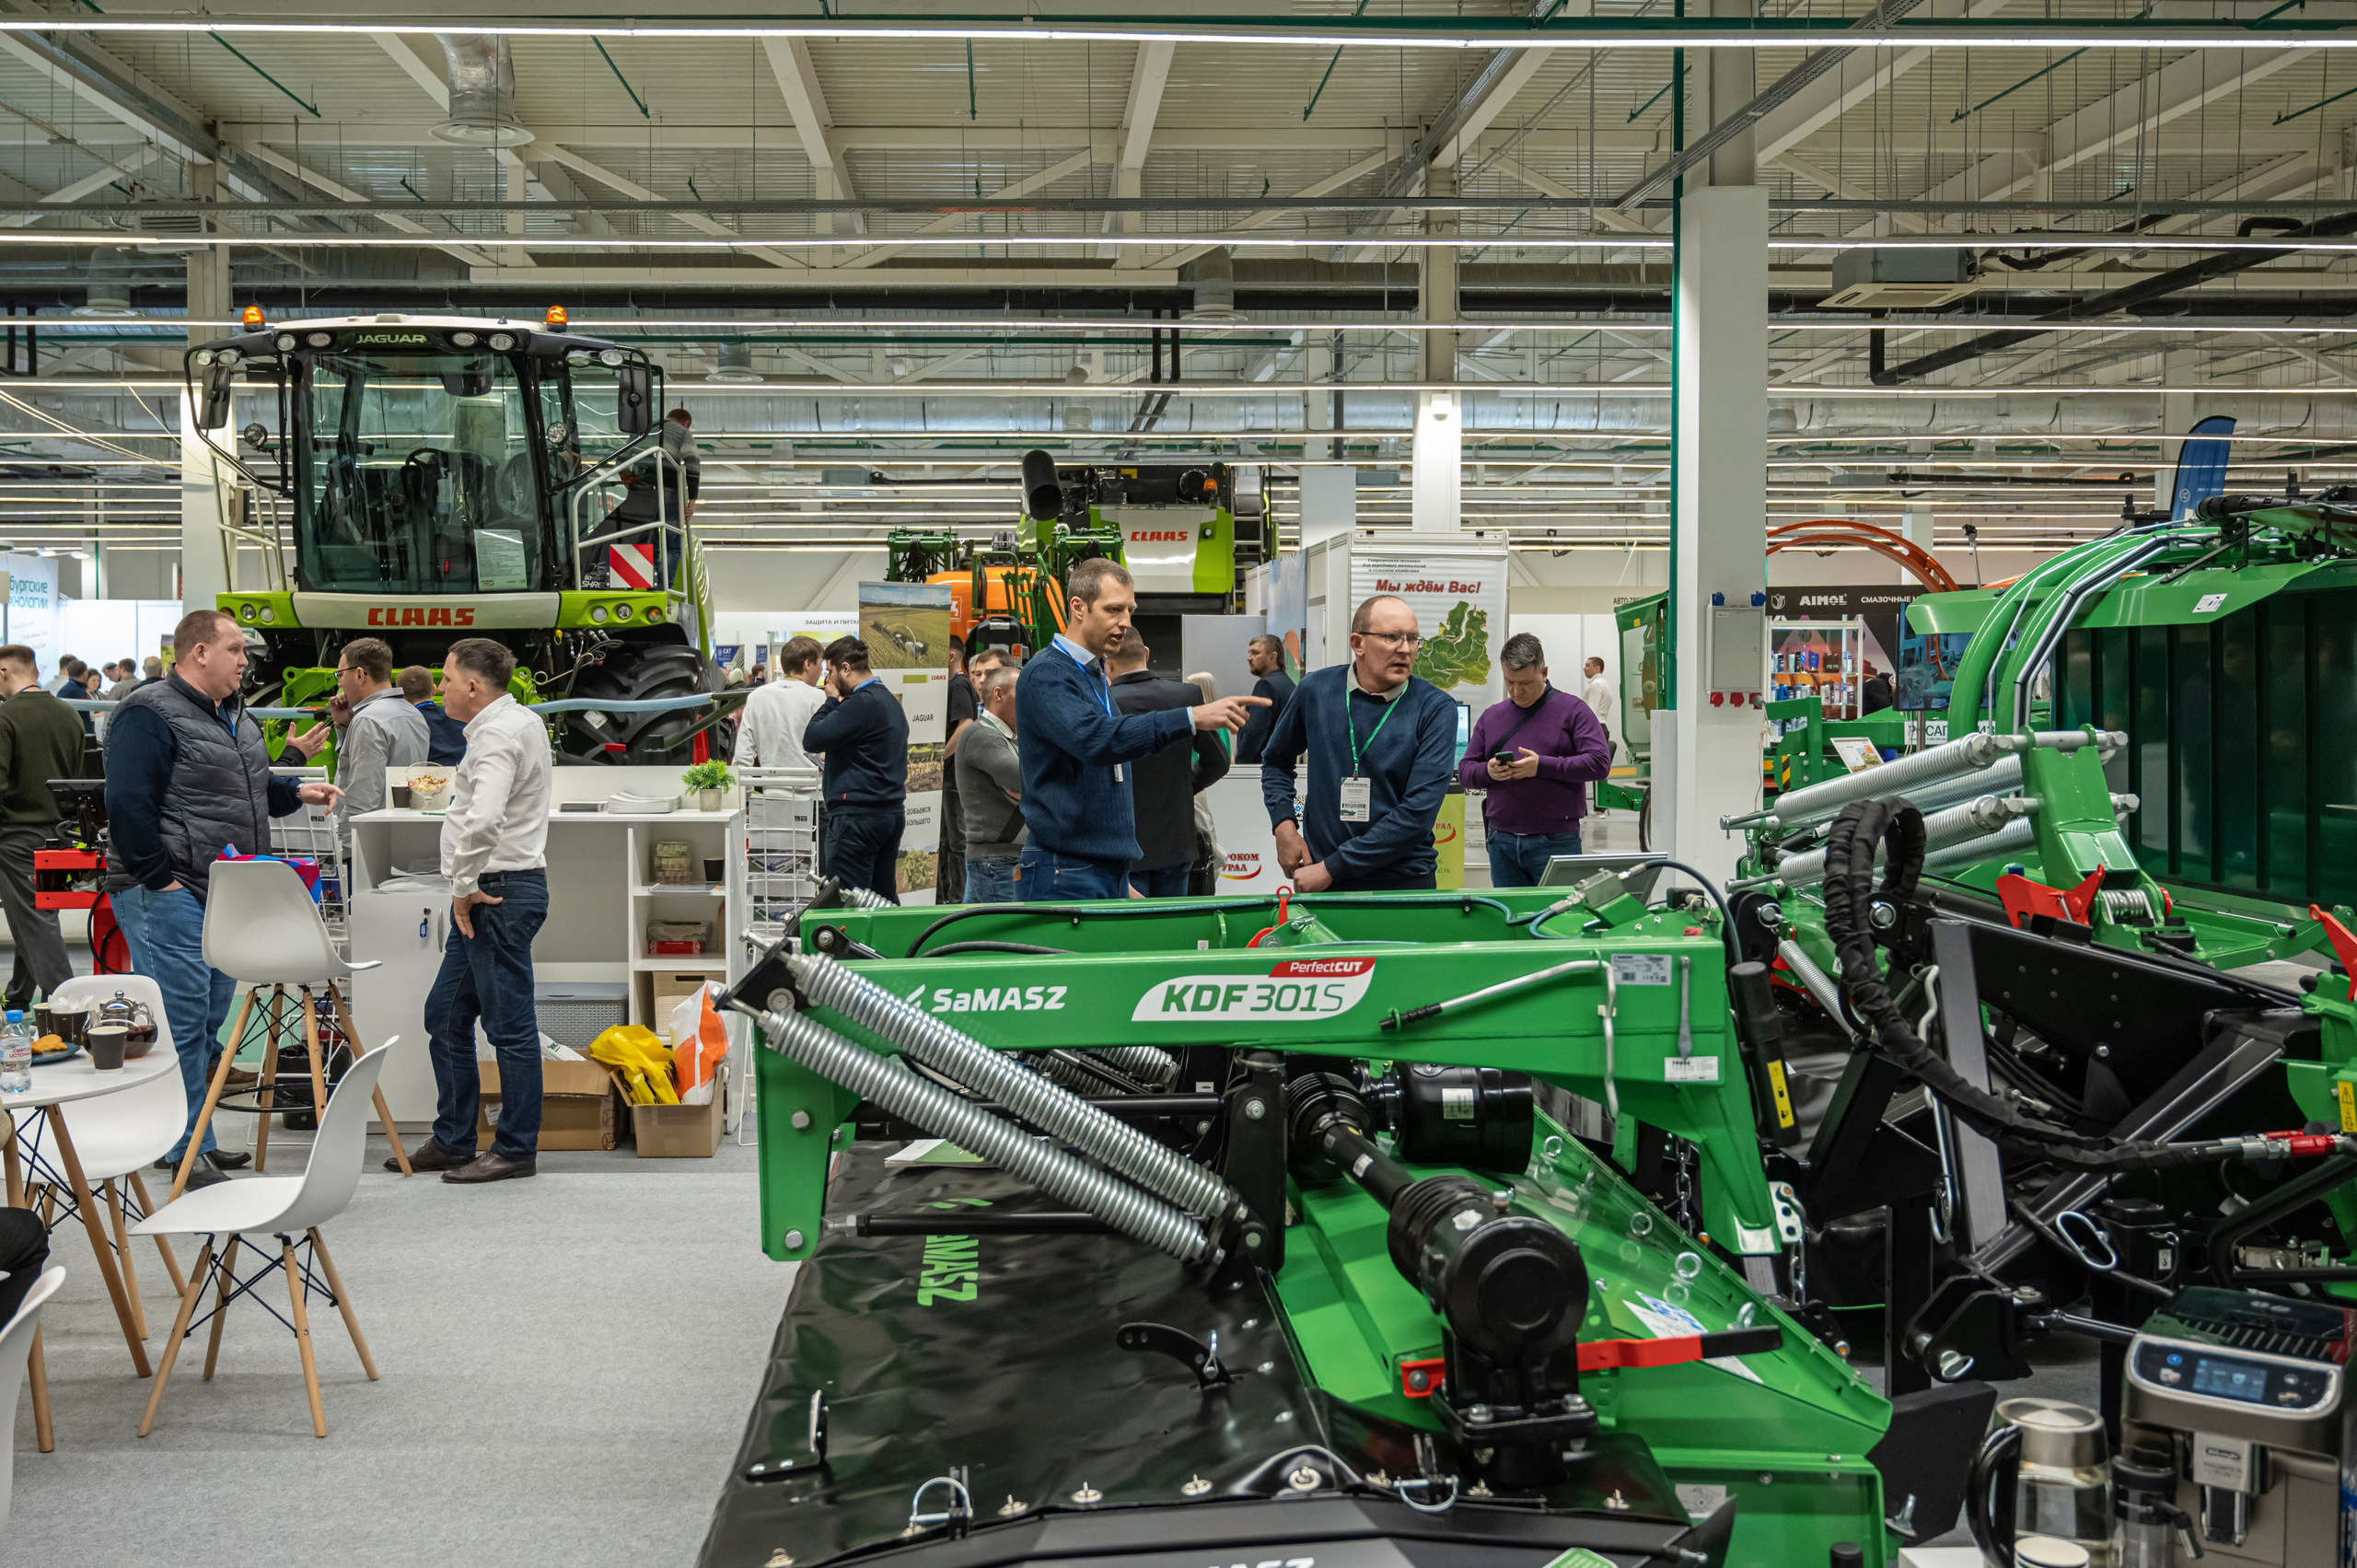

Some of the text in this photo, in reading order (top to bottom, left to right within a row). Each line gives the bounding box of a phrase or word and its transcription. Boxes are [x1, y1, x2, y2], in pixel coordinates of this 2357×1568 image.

[356, 334, 427, 343] JAGUAR
[1131, 531, 1188, 541] CLAAS
[10, 575, 48, 594] бургские
[1376, 579, 1481, 593] Мы ждём Вас!
[1861, 596, 1911, 604] СМАЗОЧНЫЕ
[368, 608, 475, 626] CLAAS
[912, 714, 934, 722] JAGUAR
[1290, 961, 1364, 974] PerfectCUT
[932, 986, 1067, 1012] SaMASZ
